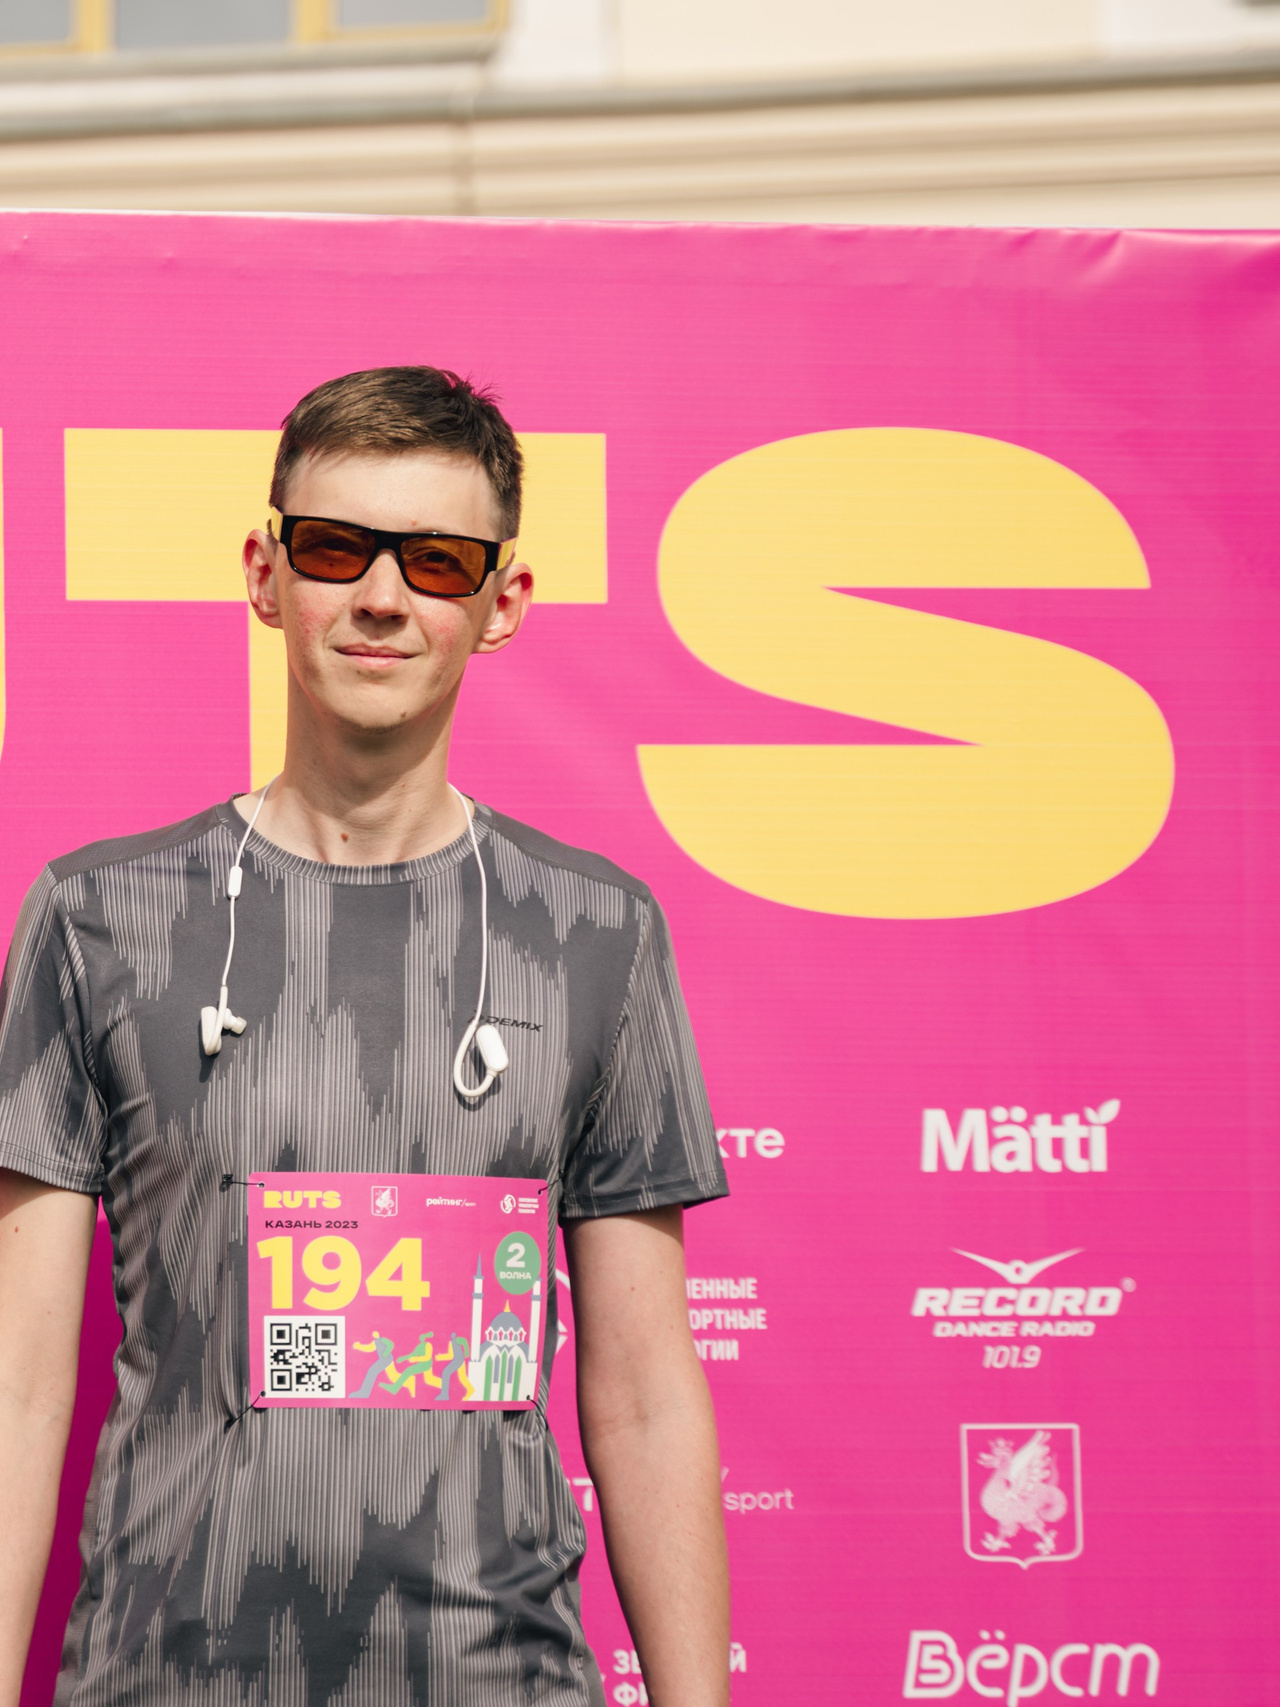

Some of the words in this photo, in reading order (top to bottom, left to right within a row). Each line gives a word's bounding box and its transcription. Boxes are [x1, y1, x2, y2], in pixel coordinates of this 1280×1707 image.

[485, 1015, 544, 1032] DEMIX
[921, 1100, 1120, 1172] Mätti
[264, 1190, 342, 1209] RUTS
[265, 1220, 322, 1229] КАЗАНЬ
[325, 1221, 359, 1229] 2023
[506, 1243, 526, 1268] 2
[256, 1235, 430, 1311] 194
[499, 1271, 532, 1280] ВОЛНА
[911, 1286, 1122, 1316] RECORD
[933, 1320, 1018, 1337] DANCE
[1019, 1320, 1096, 1337] RADIO
[983, 1345, 1041, 1369] 101.9
